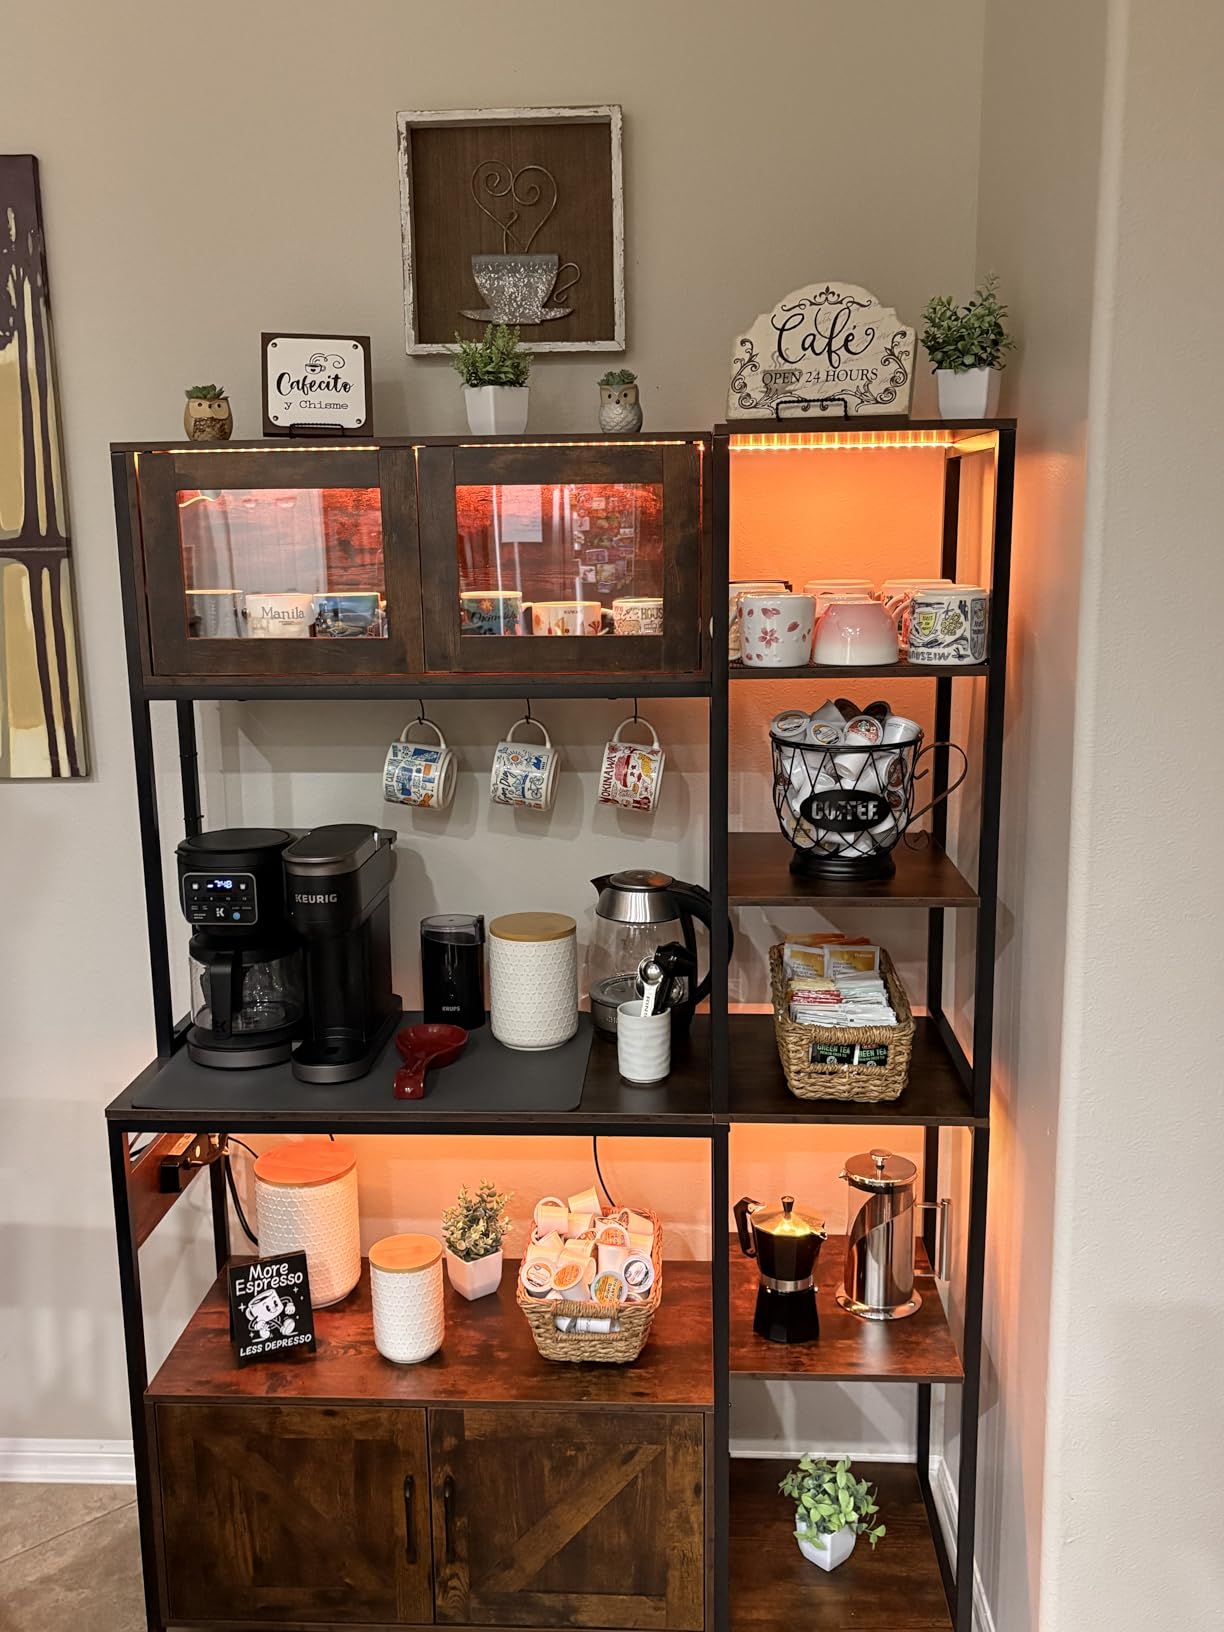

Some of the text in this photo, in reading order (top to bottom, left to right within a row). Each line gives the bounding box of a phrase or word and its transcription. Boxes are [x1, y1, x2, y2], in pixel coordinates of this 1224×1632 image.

[770, 306, 876, 369] Café
[276, 372, 355, 397] Cafecito
[761, 368, 879, 386] OPEN 24 HOURS
[284, 400, 349, 411] y Chisme
[261, 606, 305, 620] Manila
[601, 755, 617, 797] OKINAWA
[811, 800, 879, 820] COFFEE
[294, 893, 338, 904] KEURIG
[840, 1046, 850, 1054] TEA
[859, 1048, 887, 1057] REEN TEA
[248, 1263, 289, 1281] More
[235, 1272, 304, 1297] Espresso
[240, 1333, 312, 1357] LESS DEPRESSO
